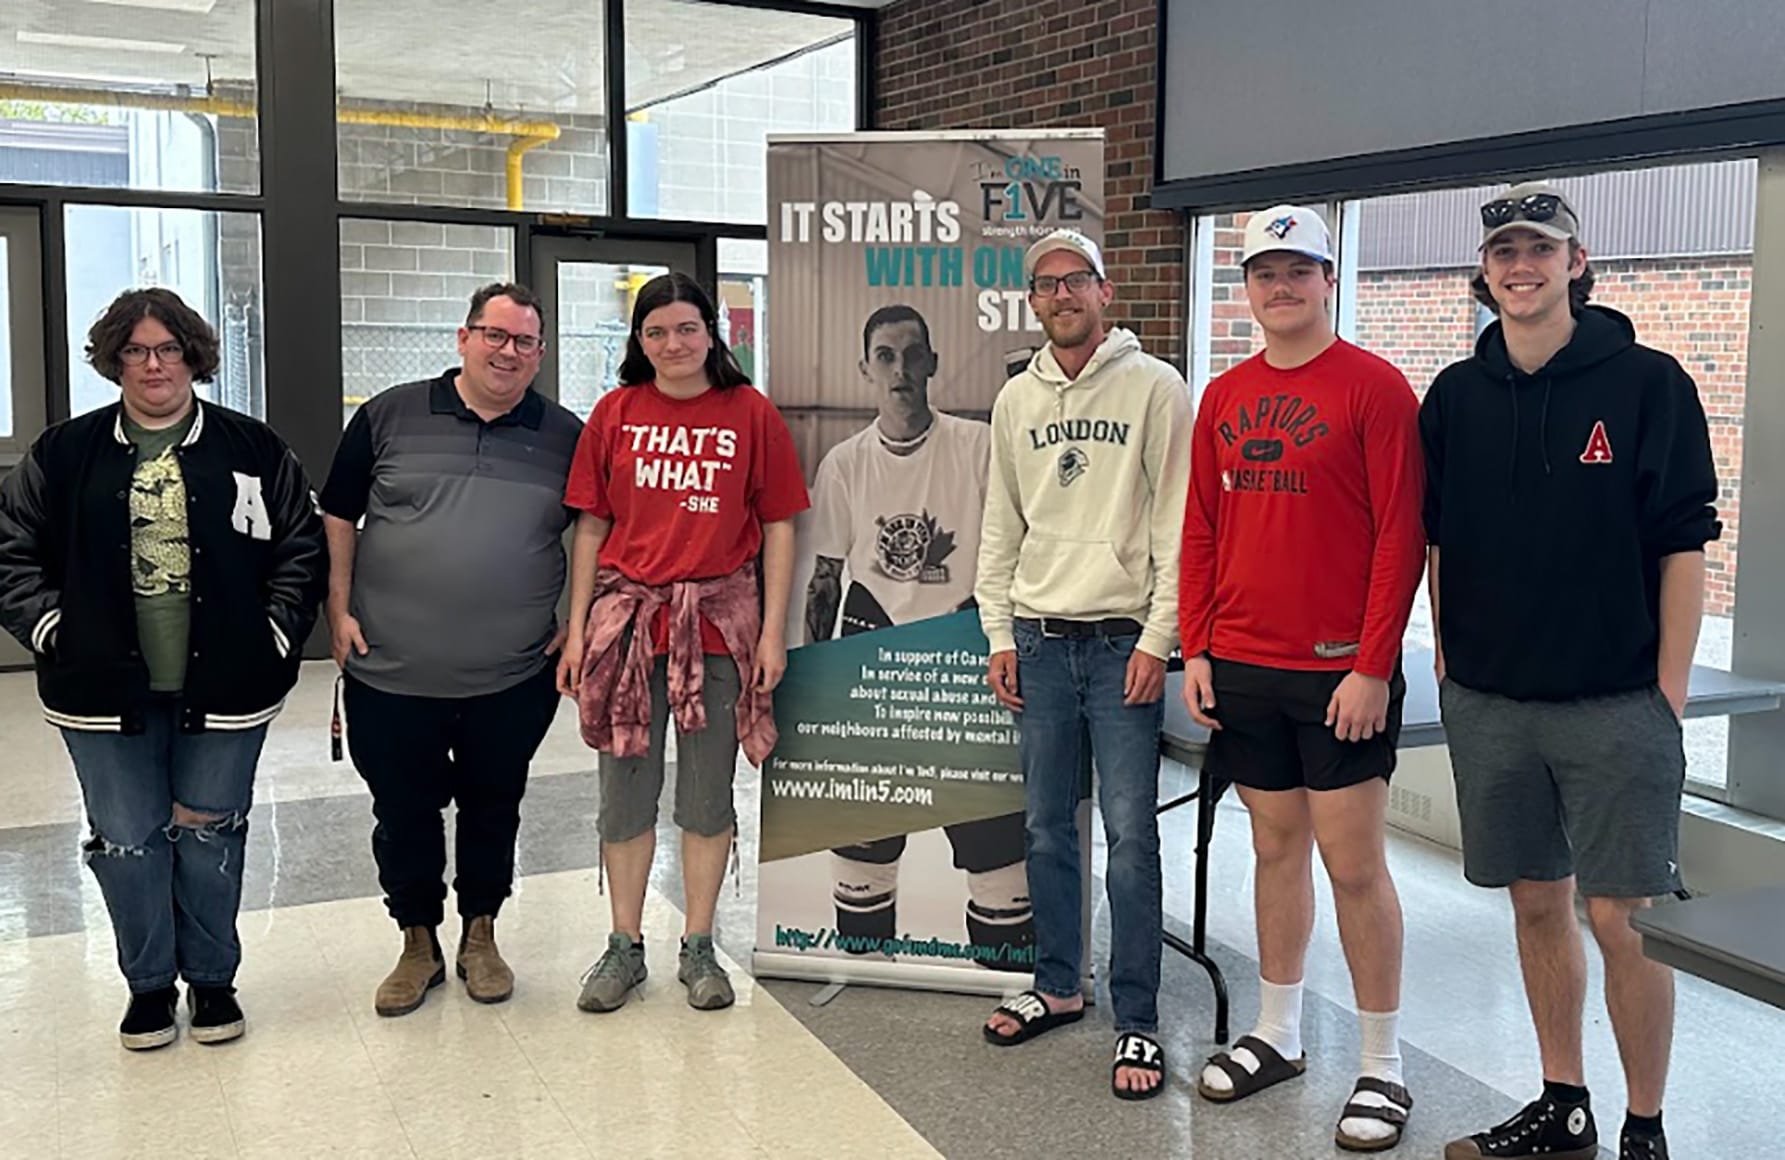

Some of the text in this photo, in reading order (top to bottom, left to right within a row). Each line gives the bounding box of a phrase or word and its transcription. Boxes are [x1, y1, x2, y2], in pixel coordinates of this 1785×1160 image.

[1004, 154, 1062, 180] ONE
[1063, 165, 1081, 179] in
[781, 202, 960, 243] IT STARTS
[982, 226, 1028, 237] strength
[866, 247, 1024, 288] WITH ON
[1218, 394, 1329, 448] RAPTORS
[1029, 419, 1130, 450] LONDON
[1579, 420, 1613, 463] A
[231, 471, 272, 540] A
[878, 647, 892, 662] In
[895, 651, 942, 666] support
[944, 649, 959, 666] of
[862, 665, 875, 680] In
[878, 667, 921, 682] service
[923, 667, 939, 684] of
[941, 672, 949, 684] a
[953, 673, 980, 685] new
[850, 684, 997, 705] about sexual abuse and
[874, 704, 887, 719] To
[889, 704, 931, 722] inspire
[934, 710, 960, 722] new
[797, 722, 819, 735] our
[821, 720, 889, 738] neighbours
[892, 724, 943, 741] affected
[946, 727, 961, 744] by
[965, 729, 1010, 744] mental
[789, 760, 813, 771] more
[815, 759, 869, 773] information
[871, 763, 897, 775] about
[940, 766, 969, 781] please
[971, 767, 990, 781] visit
[992, 771, 1008, 782] our
